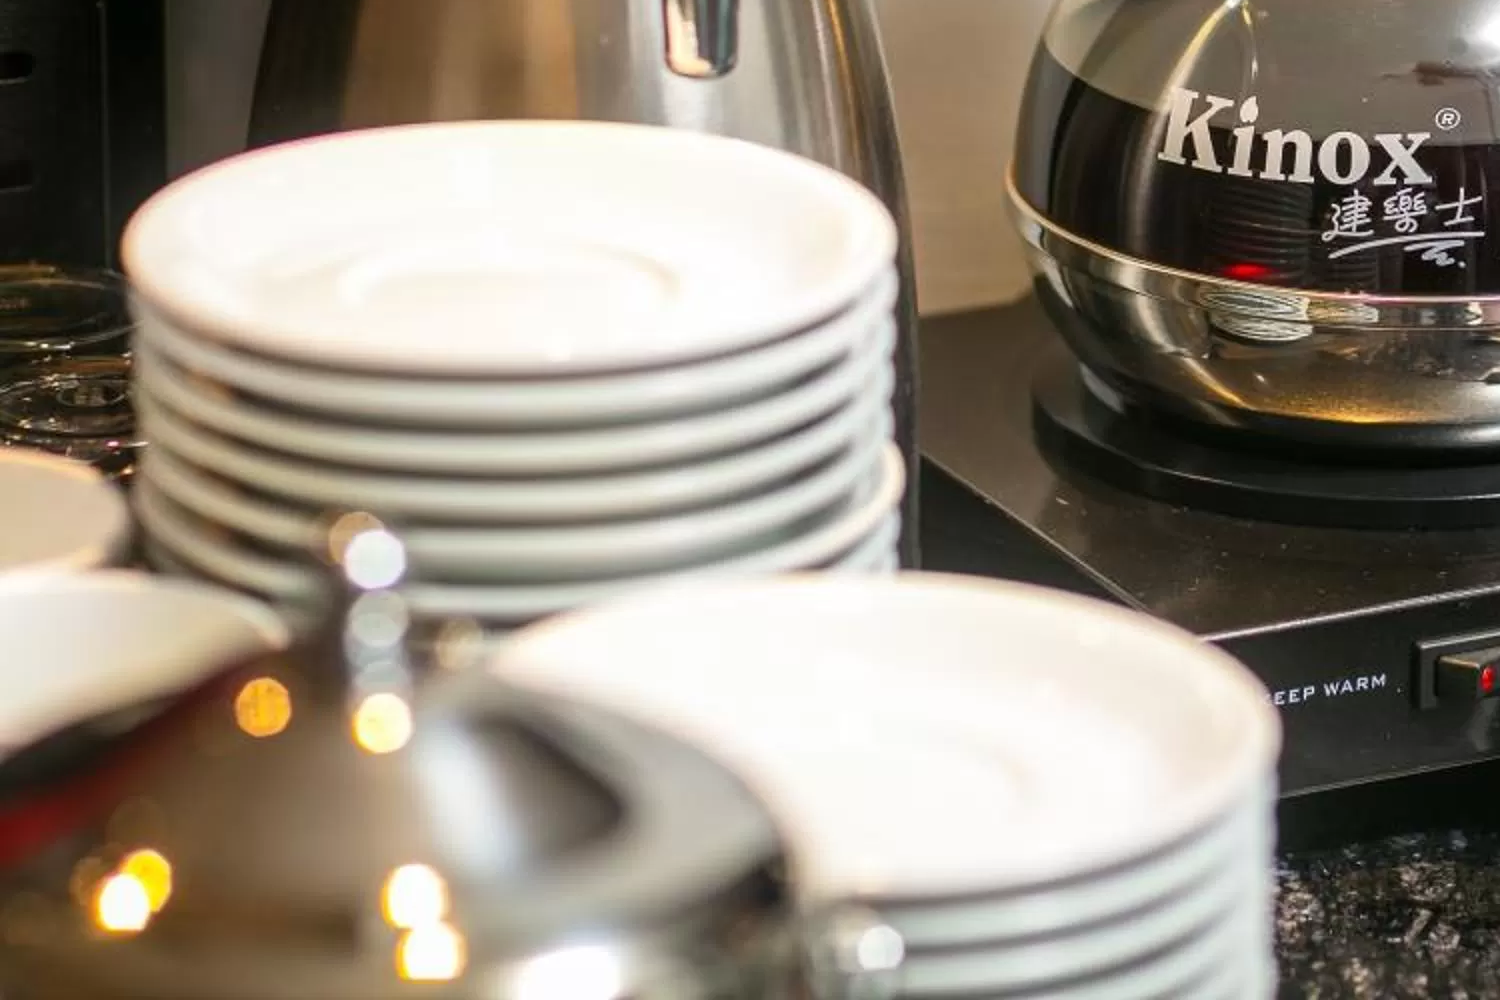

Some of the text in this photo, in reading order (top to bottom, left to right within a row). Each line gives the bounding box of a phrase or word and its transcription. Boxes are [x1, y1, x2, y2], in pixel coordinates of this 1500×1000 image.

[1157, 86, 1434, 185] Kinox
[1268, 674, 1386, 705] EEP WARM
